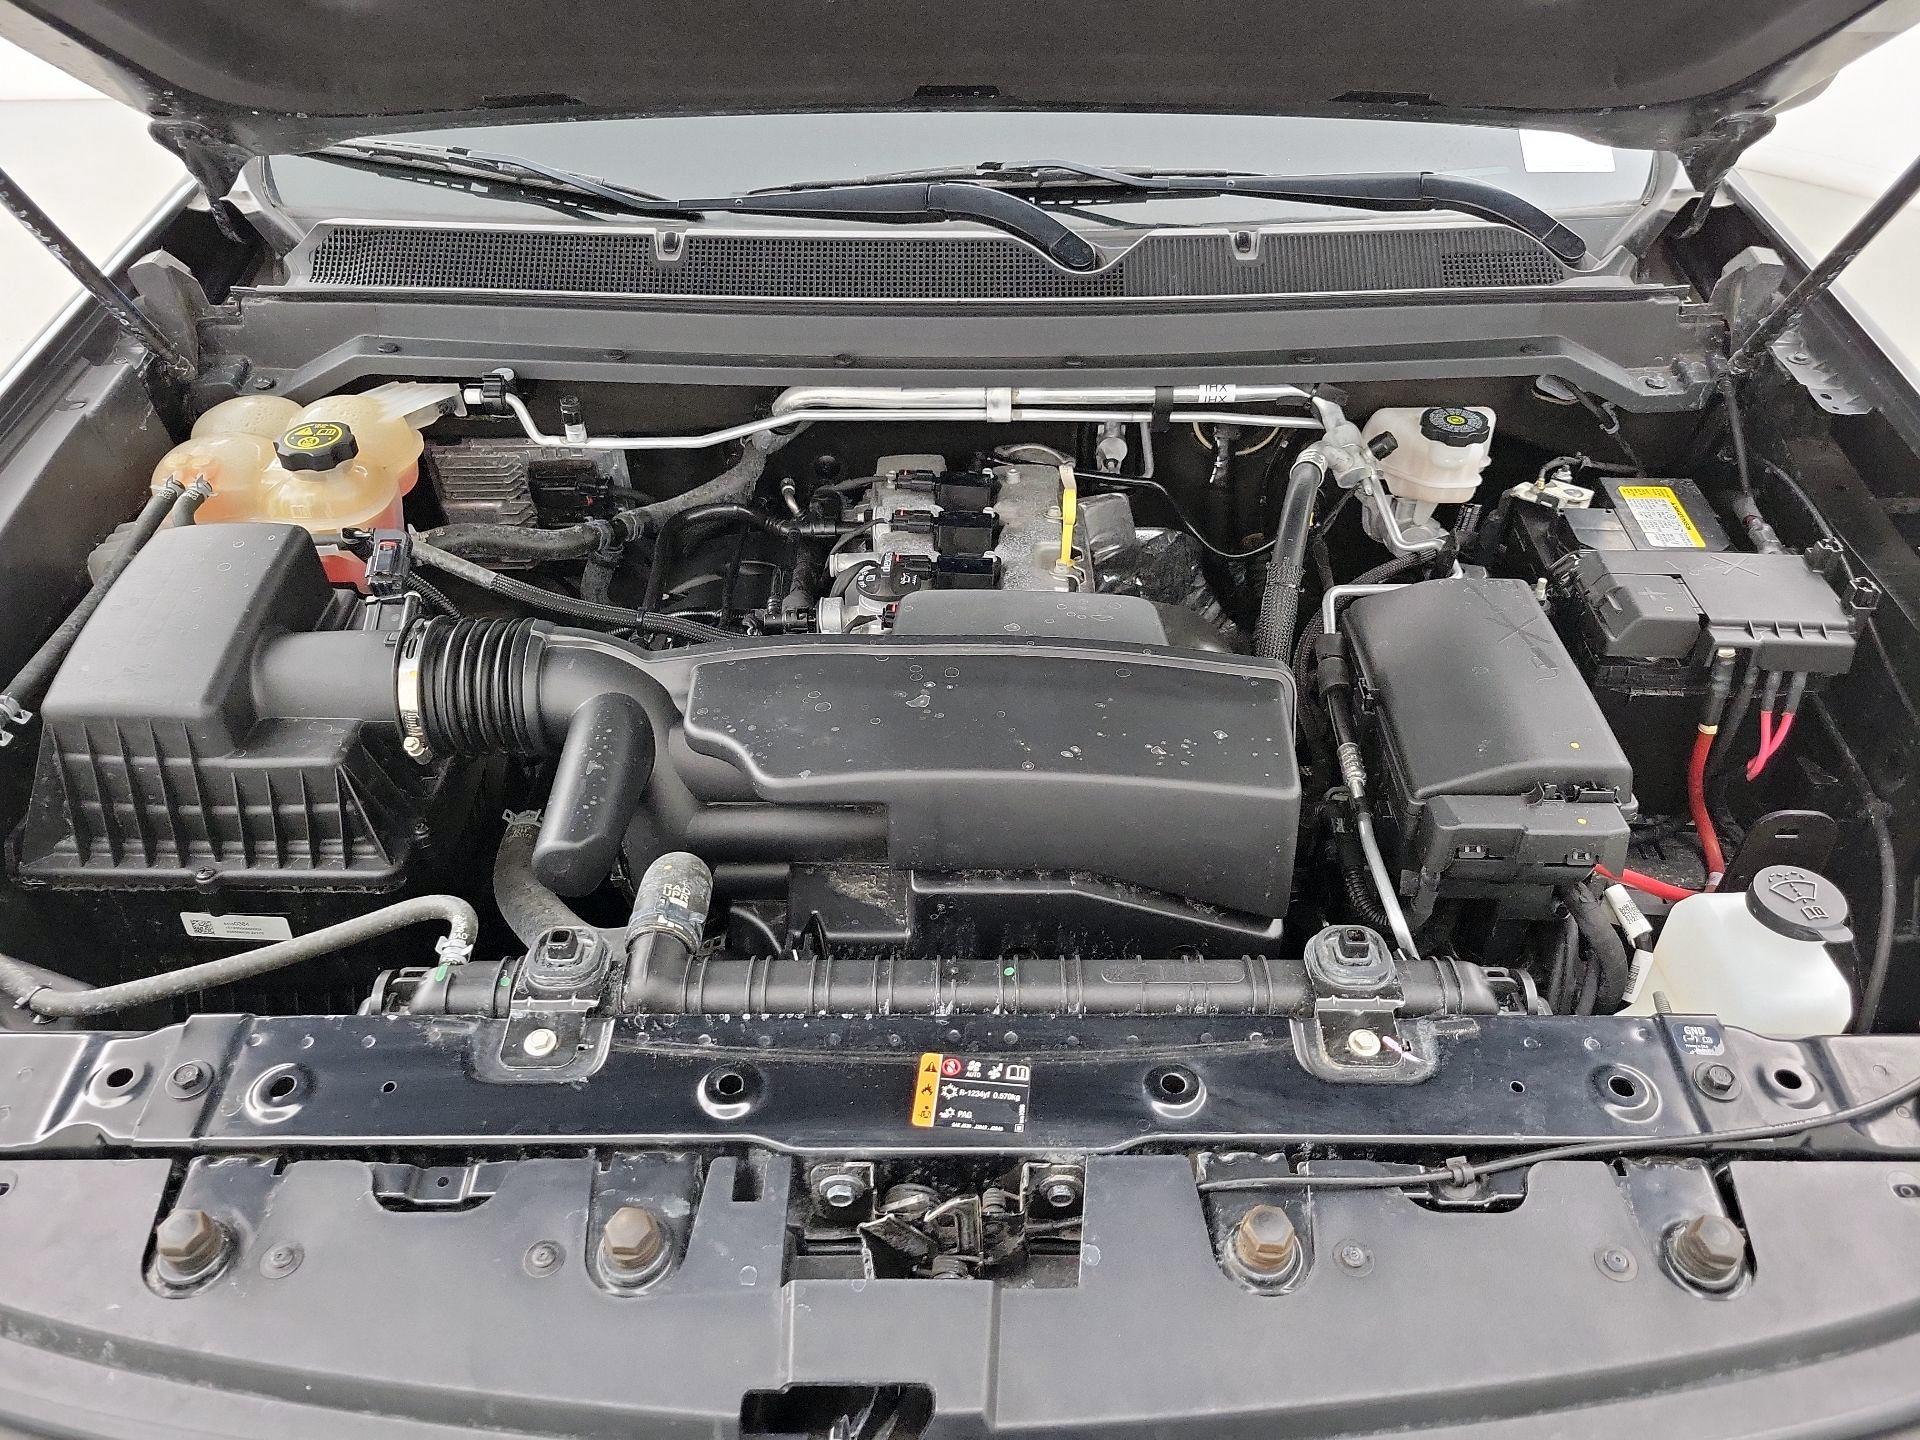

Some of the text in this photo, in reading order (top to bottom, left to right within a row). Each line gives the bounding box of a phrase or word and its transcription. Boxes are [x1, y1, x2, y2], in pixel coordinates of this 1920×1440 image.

[663, 883, 691, 896] RAD
[662, 889, 690, 903] UPR
[1683, 1025, 1706, 1036] GND
[959, 1088, 990, 1099] R-1234yf
[957, 1110, 973, 1119] PAG
